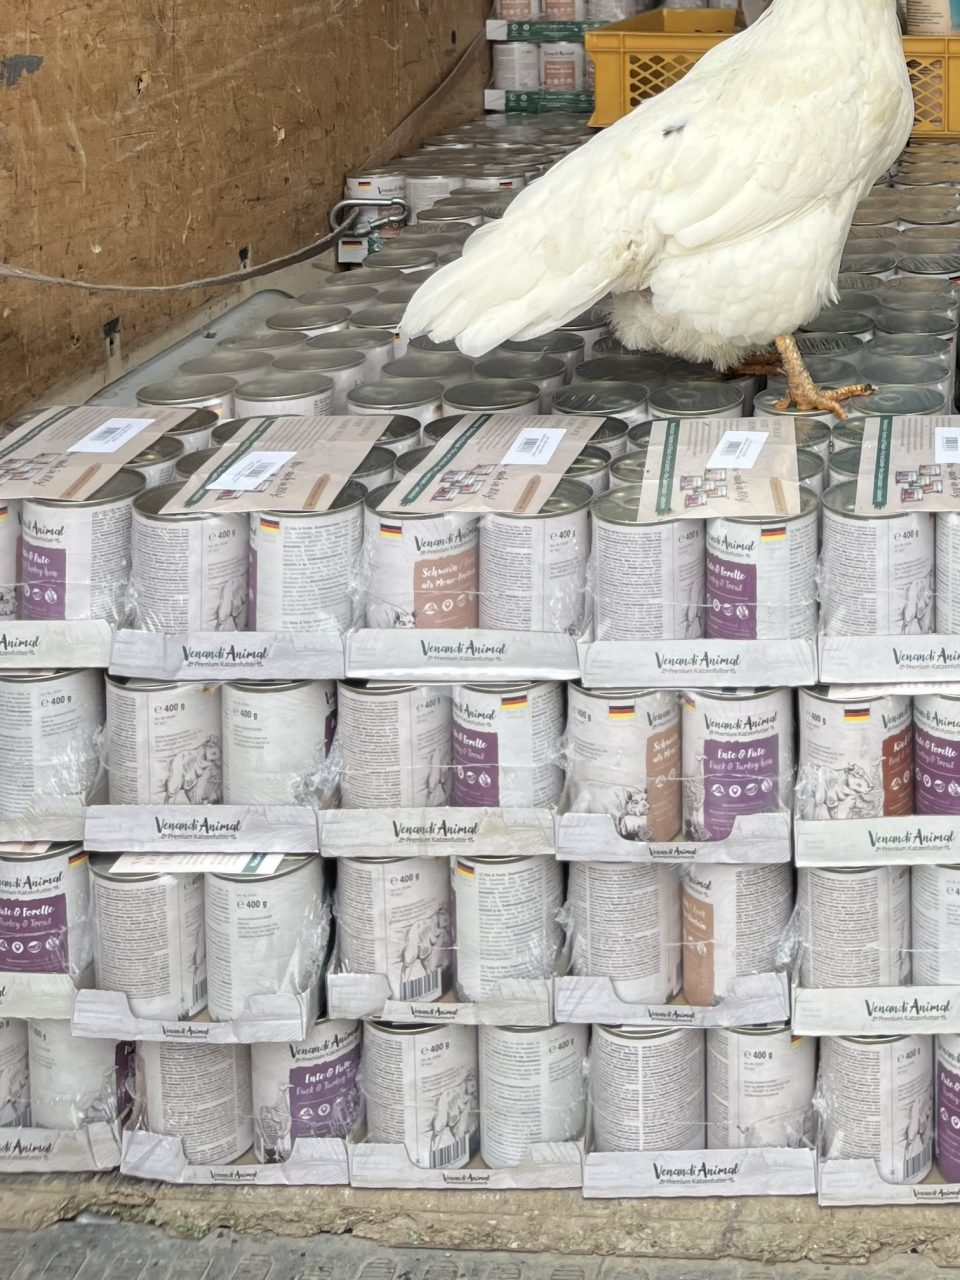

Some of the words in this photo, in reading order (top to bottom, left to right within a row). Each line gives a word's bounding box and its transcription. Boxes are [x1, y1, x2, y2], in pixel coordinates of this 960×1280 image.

[218, 530, 229, 539] 400
[902, 530, 914, 539] 400
[414, 536, 454, 551] Venandi
[721, 534, 756, 552] Animal
[0, 634, 39, 648] Animal
[420, 640, 465, 656] Venandi
[465, 639, 507, 655] Animal
[182, 645, 225, 662] Venandi
[226, 644, 268, 660] Animal
[655, 652, 698, 669] Venandi
[700, 651, 740, 668] Animal
[893, 648, 936, 664] Venandi
[51, 696, 65, 705] 400
[164, 704, 178, 712] 400
[240, 710, 252, 719] 400
[462, 703, 496, 720] Animal
[704, 713, 743, 730] Venandi
[744, 712, 777, 729] Animal
[717, 748, 736, 759] Ente
[738, 748, 746, 758] &
[747, 746, 766, 759] Pute
[931, 742, 957, 758] Forelle
[155, 816, 198, 834] Venandi
[199, 816, 241, 832] Animal
[393, 820, 436, 837] Venandi
[437, 819, 479, 836] Animal
[868, 830, 912, 848] Venandi
[913, 829, 955, 844] Animal
[649, 847, 673, 857] Venandi
[674, 847, 696, 856] Animal
[24, 872, 63, 888] Animal
[400, 874, 414, 883] 400
[23, 905, 54, 916] Forelle
[246, 900, 260, 908] 400
[410, 1005, 434, 1016] Venandi
[435, 1006, 458, 1016] Animal
[648, 1009, 672, 1019] Venandi
[672, 1010, 695, 1019] Animal
[865, 999, 908, 1016] Venandi
[909, 998, 951, 1014] Animal
[289, 1039, 329, 1061] Venandi
[430, 1043, 444, 1053] 400
[754, 1051, 767, 1060] 400
[305, 1071, 325, 1083] Ente
[442, 1172, 466, 1182] Venandi
[466, 1173, 490, 1182] Animal
[653, 1162, 697, 1179] Venandi
[698, 1162, 739, 1177] Animal
